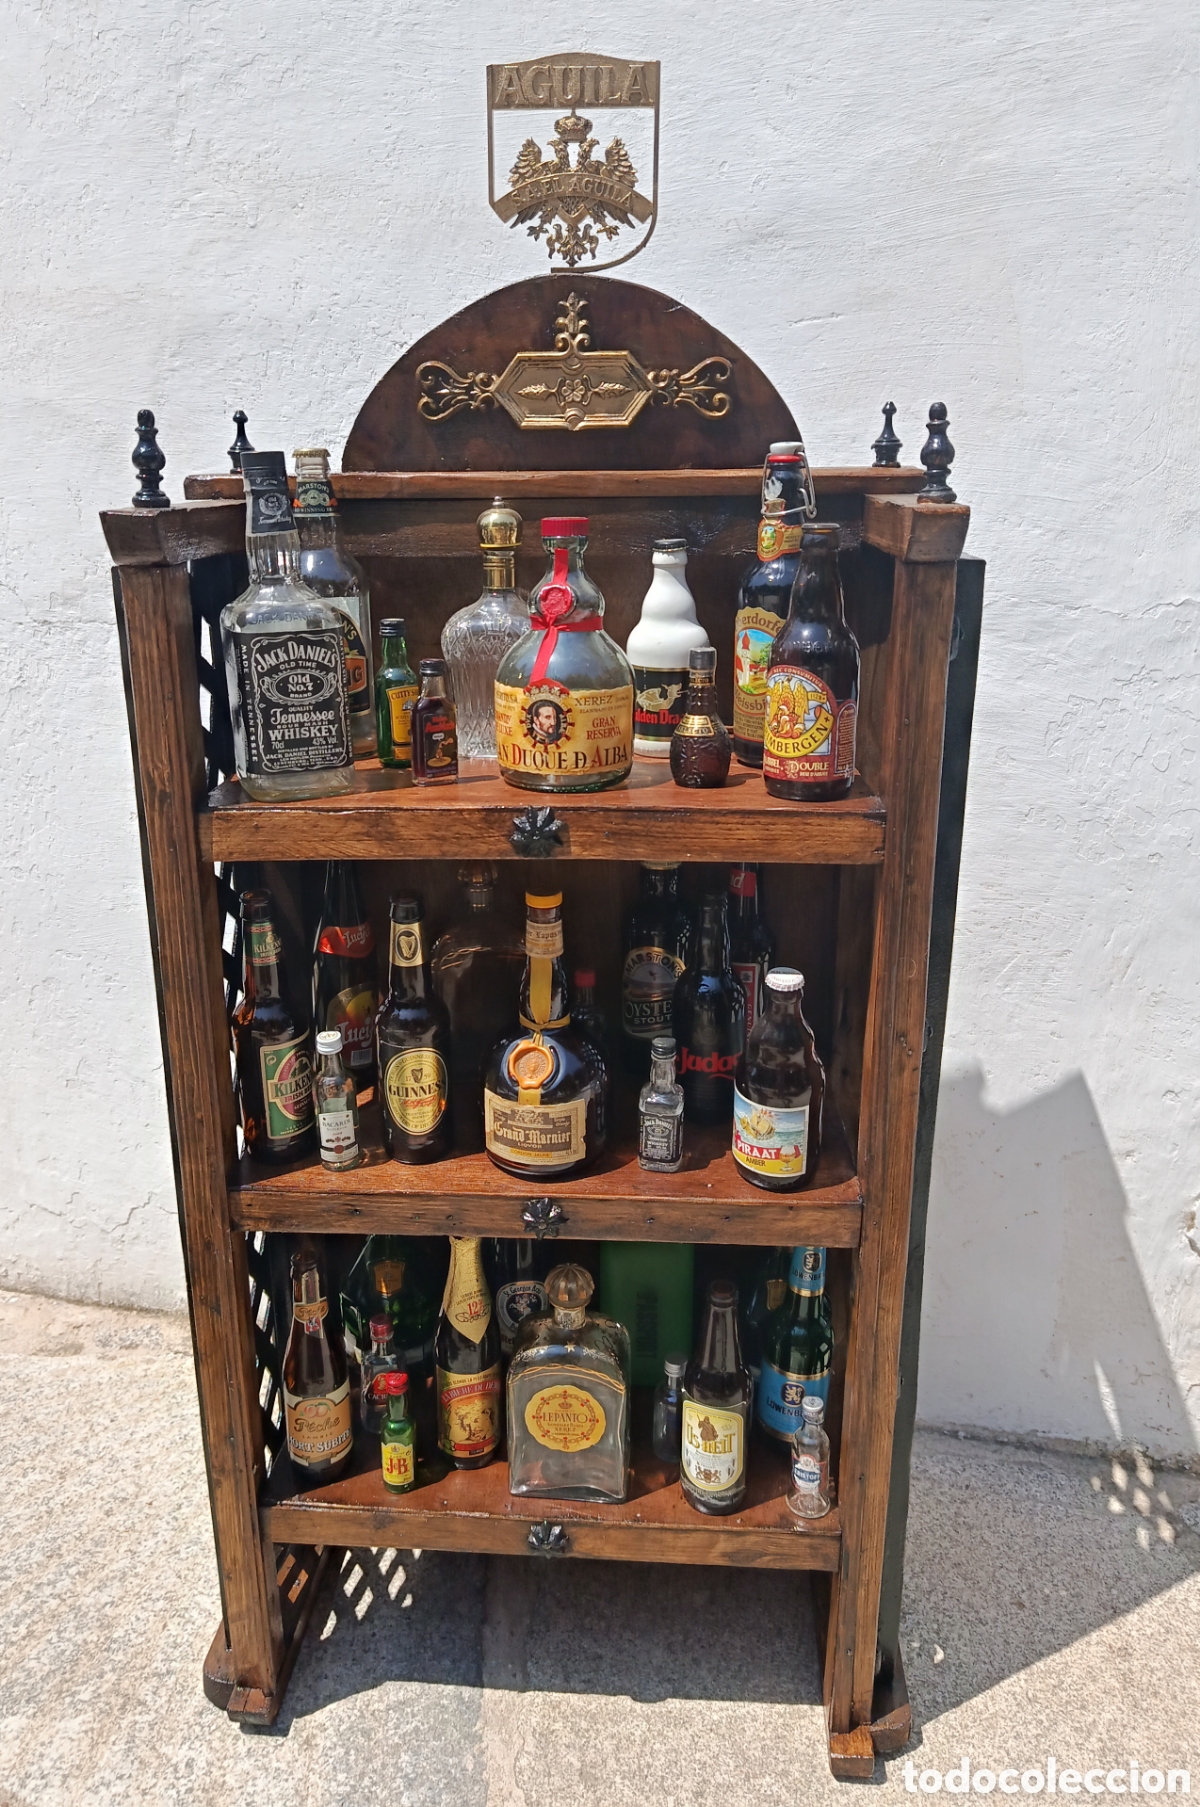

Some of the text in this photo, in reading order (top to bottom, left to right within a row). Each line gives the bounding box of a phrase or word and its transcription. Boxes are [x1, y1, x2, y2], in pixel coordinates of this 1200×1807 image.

[494, 64, 654, 104] AGUILA
[568, 176, 634, 208] AGUILA
[256, 646, 289, 673] JACK
[287, 640, 338, 668] DANIEL'S
[280, 660, 318, 670] OLD TIME
[288, 674, 310, 684] Old
[784, 667, 824, 688] CONSUMITUR
[390, 688, 412, 700] CUTTY
[574, 695, 613, 707] XEREZ
[240, 644, 258, 762] MADE IN TENNESSEE
[270, 708, 335, 725] Tennessee
[592, 716, 616, 728] GRAN
[660, 708, 683, 726] Dra
[268, 724, 339, 741] WHISKEY
[586, 726, 622, 740] RESERVA
[271, 741, 285, 750] 70cl
[312, 738, 326, 746] 43%
[511, 744, 568, 772] DUQUE
[590, 743, 628, 768] ALBA
[789, 760, 830, 773] DOUBLE
[625, 952, 684, 980] MARSTON'S
[624, 1000, 672, 1018] OYSTE
[634, 1014, 672, 1024] STOUT
[274, 1074, 312, 1098] KILKEN
[389, 1080, 442, 1098] GUINNES
[284, 1090, 304, 1103] IRISH
[494, 1121, 572, 1145] Grand Marnier
[737, 1139, 777, 1160] PIRAAT
[746, 1156, 766, 1167] AMBER
[542, 1412, 589, 1424] LEPANTO
